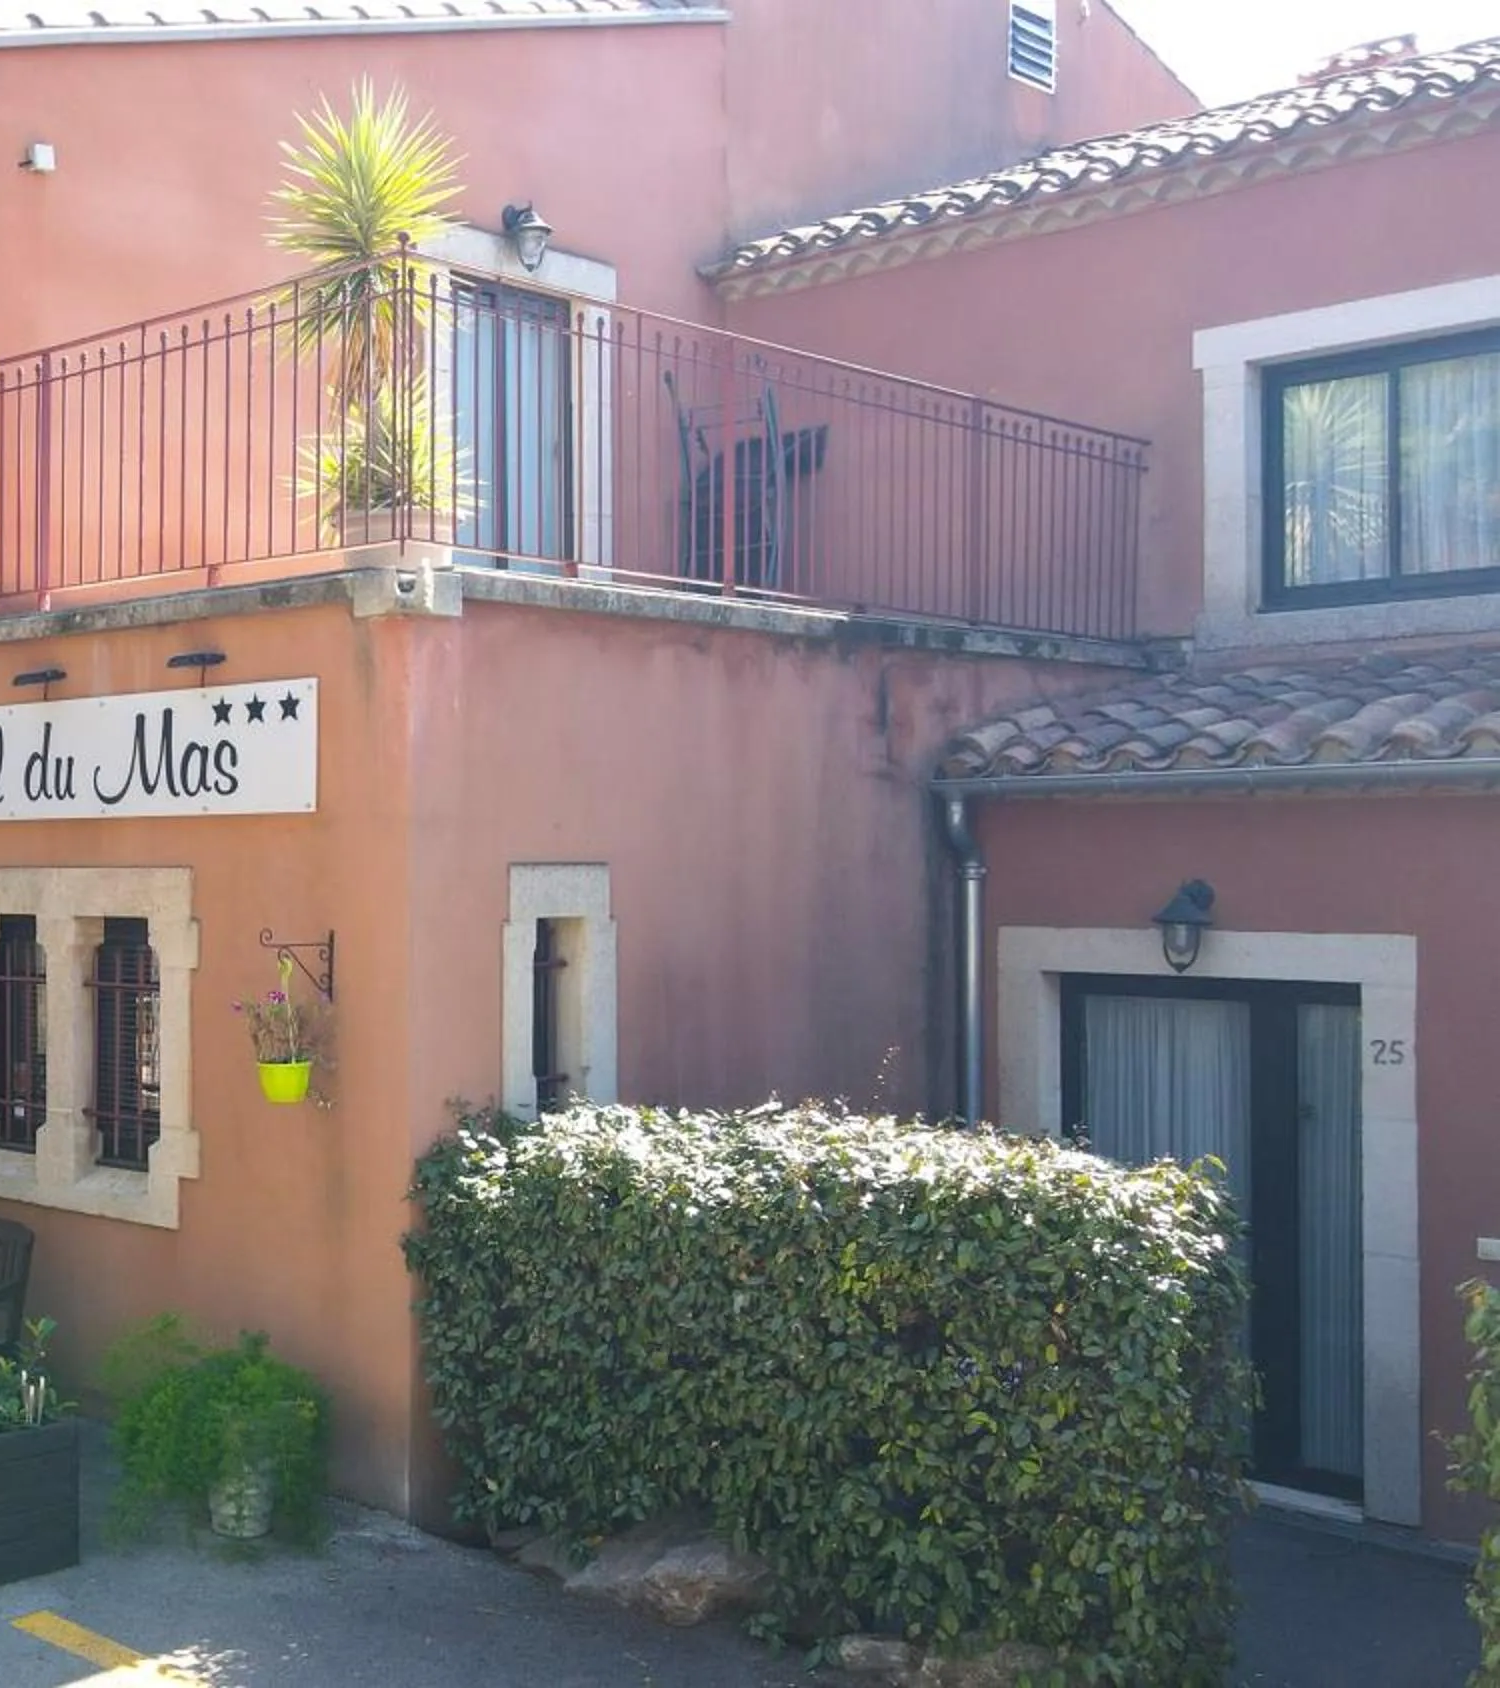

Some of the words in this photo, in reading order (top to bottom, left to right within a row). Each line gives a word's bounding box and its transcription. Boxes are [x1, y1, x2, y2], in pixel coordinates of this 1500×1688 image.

[24, 721, 76, 801] du
[93, 707, 240, 805] Mas
[1369, 1039, 1405, 1066] 25
